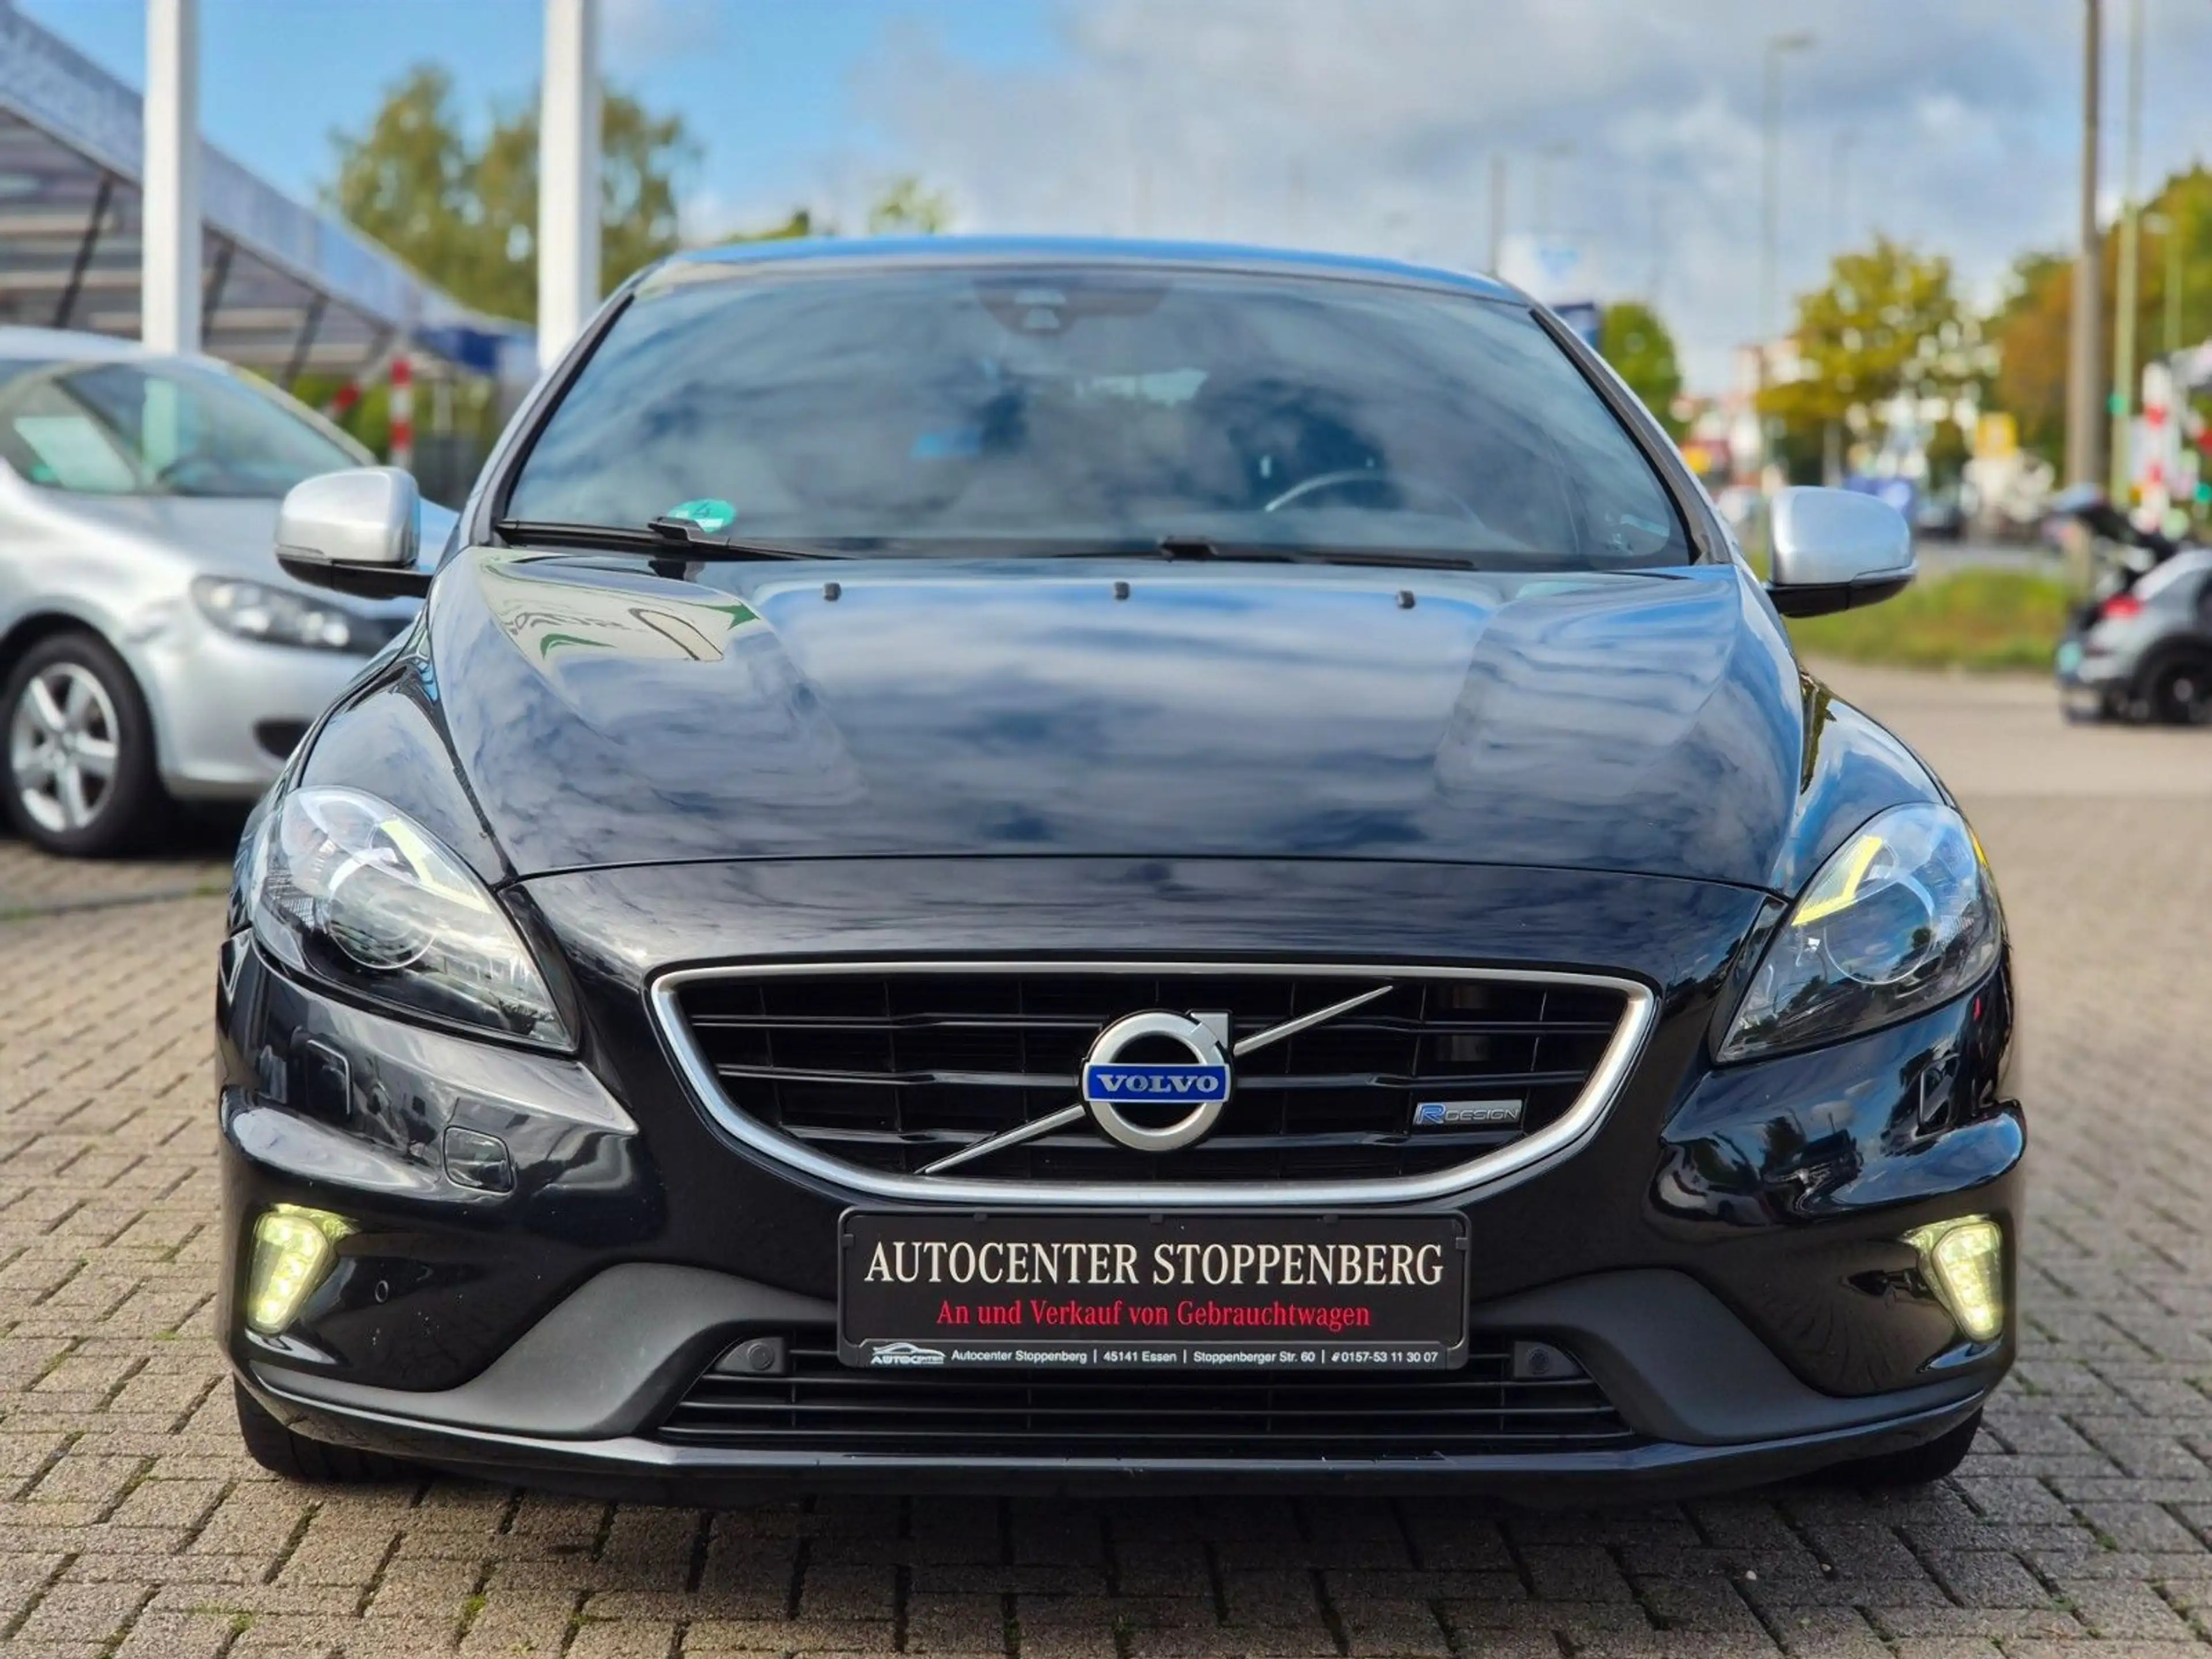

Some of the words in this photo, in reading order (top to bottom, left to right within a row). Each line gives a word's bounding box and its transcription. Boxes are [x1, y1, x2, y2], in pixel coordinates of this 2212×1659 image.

[1096, 1074, 1219, 1093] VOLVO
[864, 1241, 1139, 1284] AUTOCENTER
[1153, 1243, 1444, 1286] STOPPENBERG
[937, 1301, 970, 1324] An
[978, 1300, 1022, 1324] und
[1031, 1299, 1123, 1325] Verkauf
[1129, 1305, 1169, 1326] von
[1177, 1300, 1371, 1333] Gebrauchtwagen
[951, 1350, 1013, 1361] Autocenter
[1016, 1350, 1088, 1365] Stoppenberg
[1103, 1351, 1138, 1362] 45141
[1142, 1351, 1177, 1362] Essen
[1193, 1351, 1277, 1365] Stoppenberger
[1279, 1351, 1297, 1362] Str.
[1301, 1351, 1316, 1362] 60
[1391, 1351, 1403, 1362] 11
[1406, 1351, 1421, 1363] 30
[1423, 1351, 1438, 1363] 07
